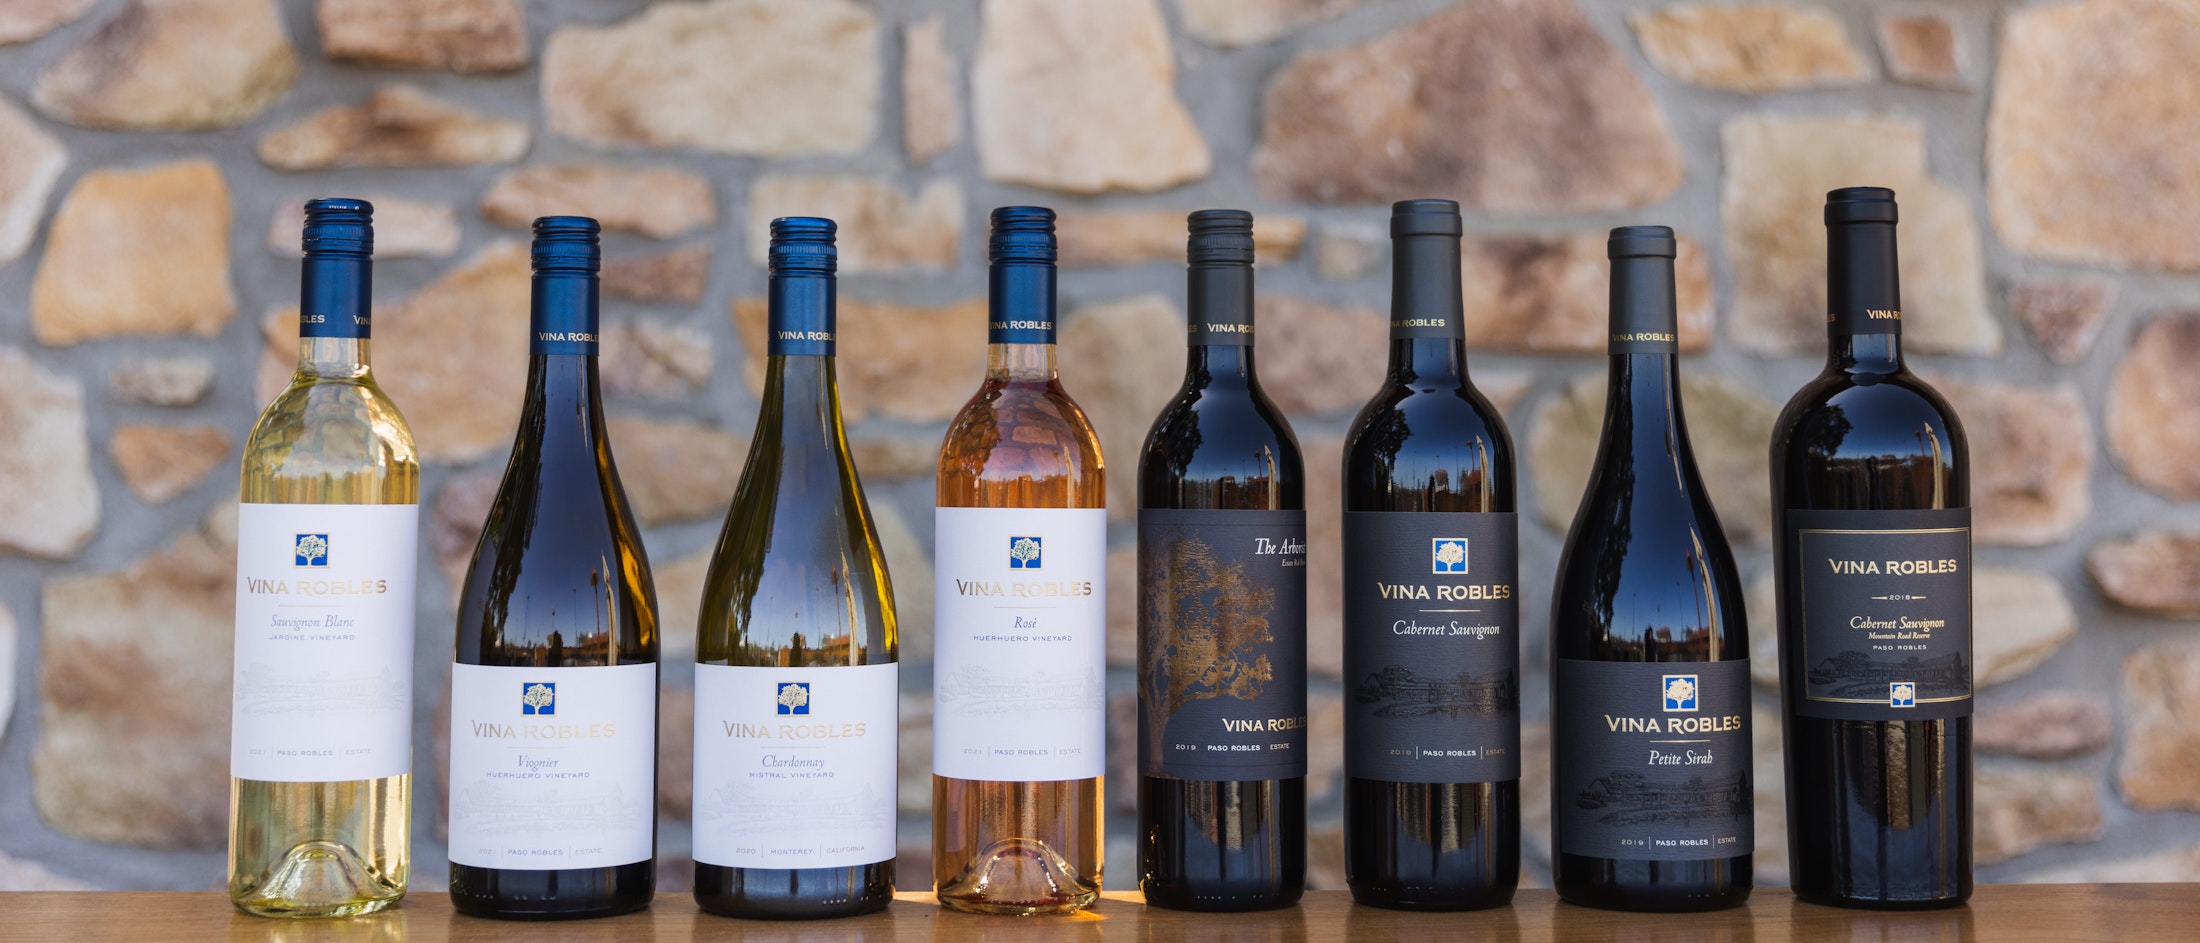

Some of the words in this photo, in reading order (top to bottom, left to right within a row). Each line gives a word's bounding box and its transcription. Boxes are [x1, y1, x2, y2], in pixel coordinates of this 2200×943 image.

[353, 314, 371, 325] VIN
[1866, 308, 1893, 320] VINA
[1009, 320, 1053, 331] ROBLES
[1206, 322, 1236, 334] VINA
[1401, 318, 1446, 329] ROBLES
[539, 331, 565, 342] VINA
[777, 330, 805, 341] VINA
[1612, 333, 1634, 342] VINA
[1635, 332, 1675, 343] ROBLES
[1255, 538, 1277, 555] The
[1828, 558, 1881, 575] VINA
[1885, 559, 1958, 577] ROBLES
[247, 576, 290, 595] VINA
[296, 579, 387, 596] ROBLES
[956, 578, 1005, 596] VINA
[1011, 581, 1092, 599] ROBLES
[1377, 582, 1431, 600] VINA
[1437, 584, 1511, 602] ROBLES
[270, 614, 320, 631] Sauvignon
[324, 614, 355, 628] Blanc
[1013, 615, 1038, 629] Rosé
[1850, 616, 1897, 630] Cabernet
[1899, 615, 1945, 633] Sauvignon
[1392, 620, 1446, 636] Cabernet
[1448, 620, 1500, 640] Sauvignon
[1868, 632, 1896, 640] Mountain
[1897, 632, 1912, 640] Road
[973, 634, 1029, 642] HUERHUERO
[1032, 634, 1073, 642] VINEYARD
[471, 719, 517, 739] VINA
[523, 722, 616, 741] ROBLES
[722, 719, 772, 739] VINA
[778, 721, 867, 741] ROBLES
[1222, 718, 1264, 732] VINA
[1604, 714, 1662, 733] VINA
[1667, 715, 1742, 735] ROBLES
[994, 748, 1015, 756] PASO
[1018, 748, 1049, 756] ROBLES
[1059, 747, 1081, 755] ESTATE
[1207, 744, 1228, 752] PASO
[1231, 744, 1261, 752] ROBLES
[1269, 742, 1290, 750] ESTATE
[1422, 749, 1444, 757] PASO
[1446, 749, 1477, 757] ROBLES
[517, 754, 560, 772] Viognier
[761, 754, 825, 772] Chardonnay
[1648, 749, 1682, 765] Petite
[1684, 749, 1713, 765] Sirah
[486, 771, 542, 779] HUERHUERO
[545, 771, 590, 779] VINEYARD
[749, 771, 787, 779] MISTRAL
[790, 771, 835, 779] VINEYARD
[1655, 839, 1677, 847] PASO
[1679, 838, 1709, 847] ROBLES
[1717, 836, 1737, 845] ESTATE
[507, 848, 528, 856] PASO
[531, 848, 564, 856] ROBLES
[575, 847, 602, 855] ESTATE
[770, 848, 814, 856] MONTEREY
[826, 845, 865, 855] CALIFORNIA
